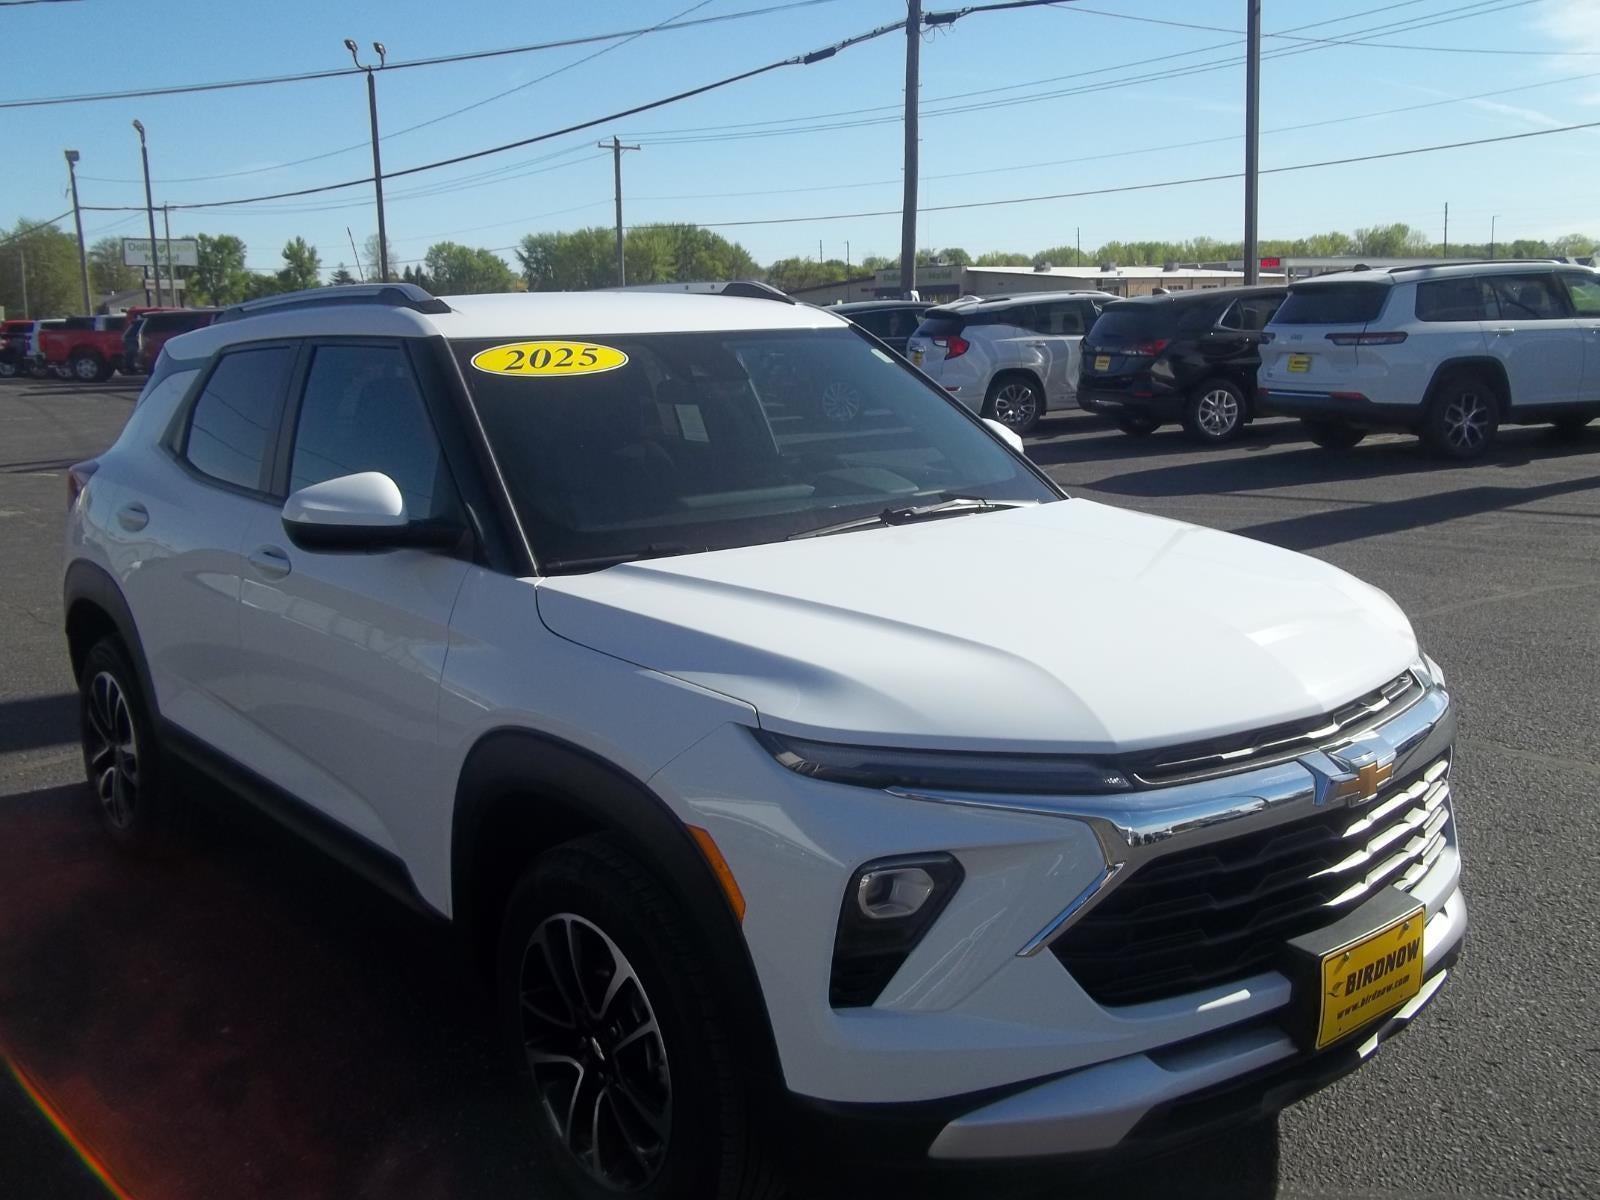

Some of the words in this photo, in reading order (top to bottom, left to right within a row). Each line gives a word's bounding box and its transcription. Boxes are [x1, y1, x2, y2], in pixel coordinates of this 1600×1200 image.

[504, 347, 598, 371] 2025
[1344, 937, 1420, 997] BIRDNOW
[1336, 974, 1410, 1020] www.birdnow.com
